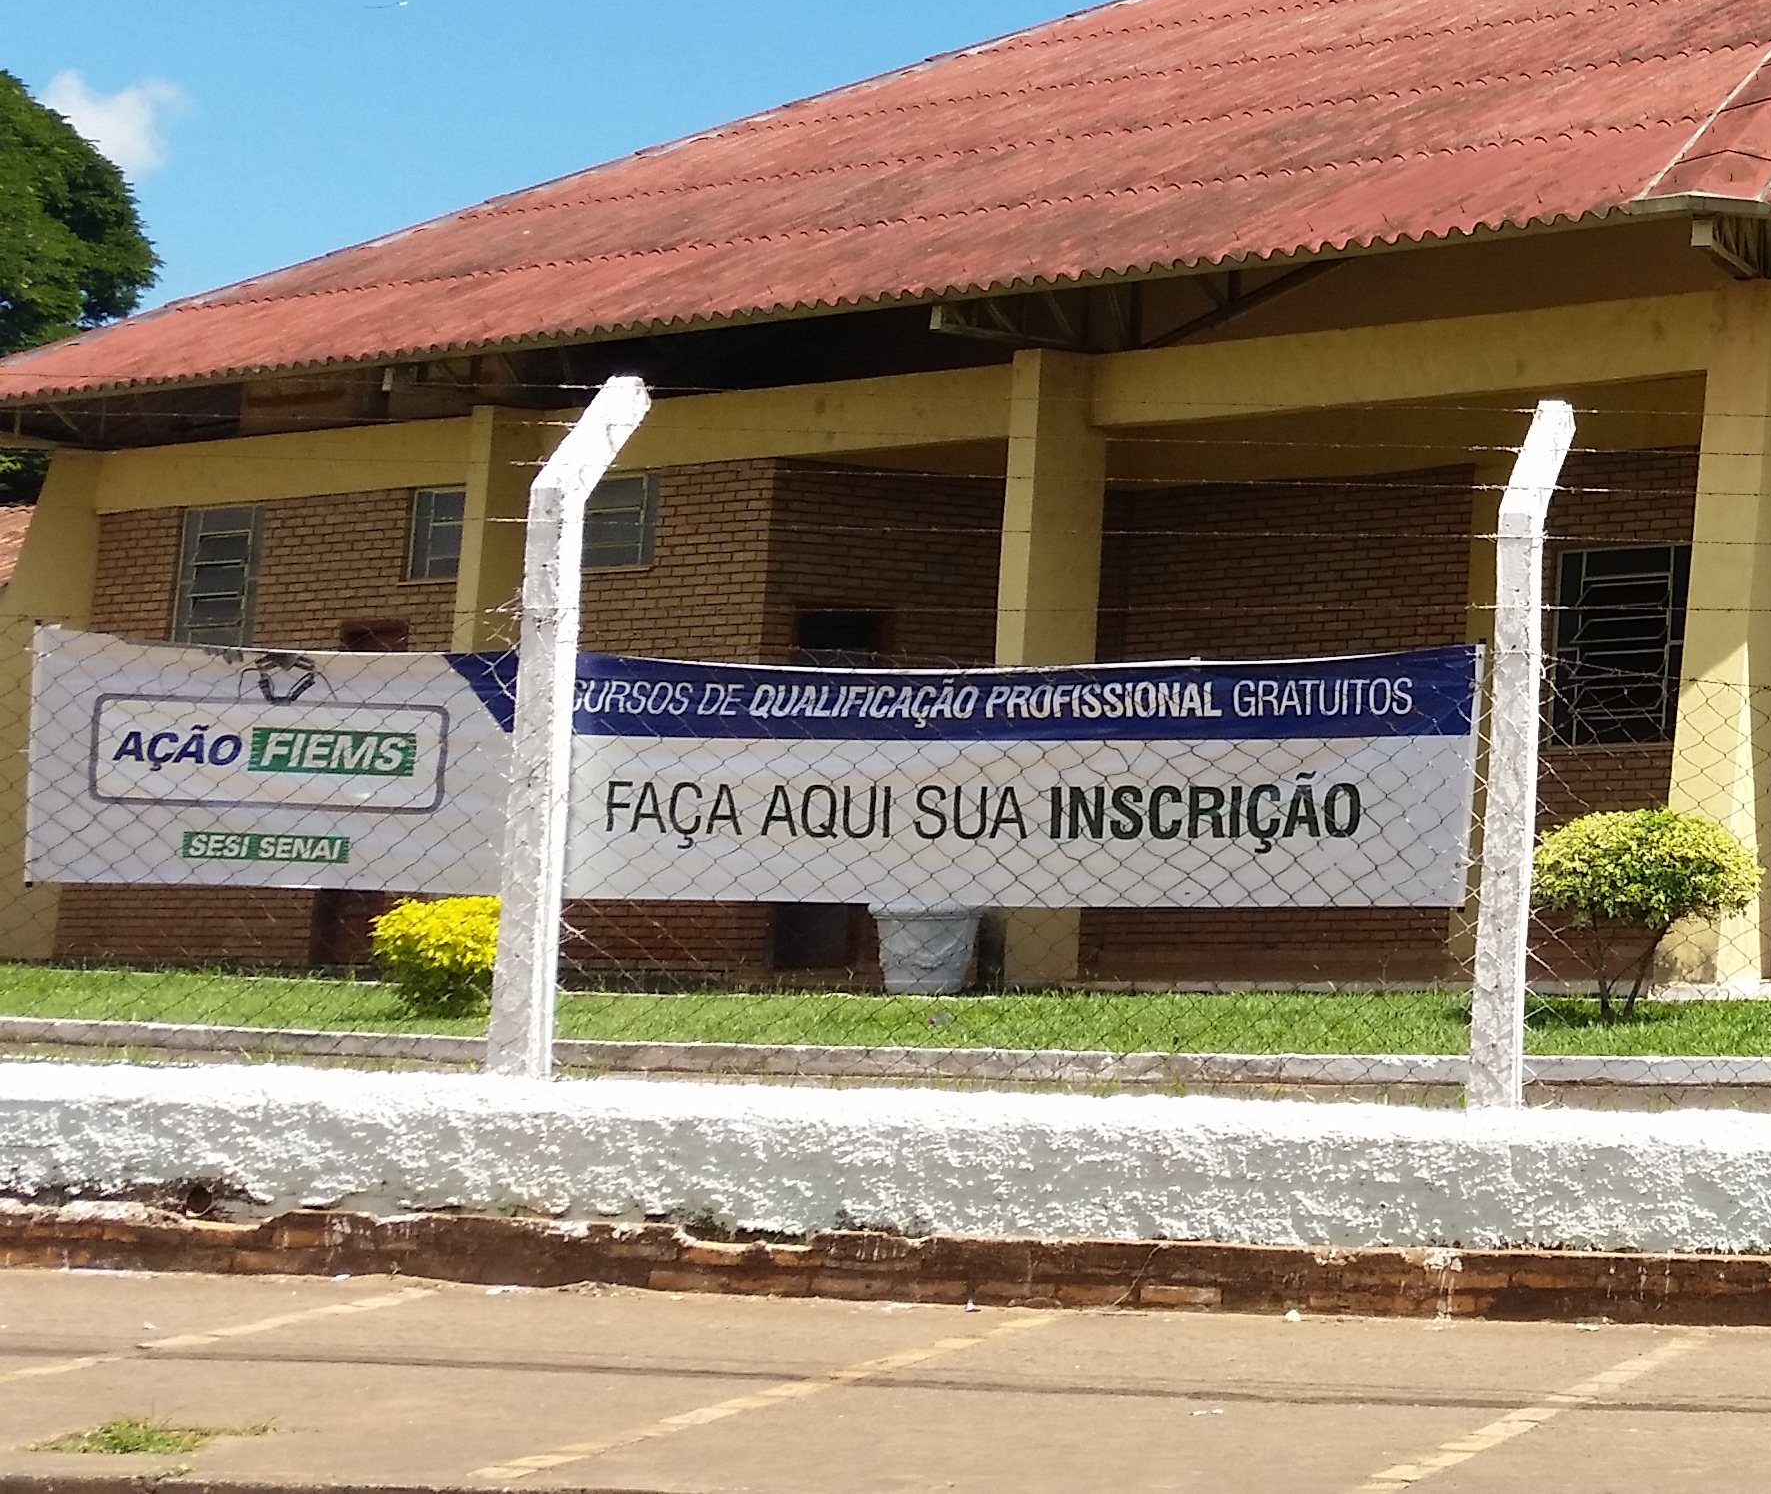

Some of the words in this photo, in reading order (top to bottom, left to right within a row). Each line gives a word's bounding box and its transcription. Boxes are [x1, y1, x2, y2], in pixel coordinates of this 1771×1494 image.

[697, 683, 745, 717] DE
[748, 679, 980, 728] QUALIFICAÇÃO
[984, 679, 1223, 719] PROFISSIONAL
[1232, 677, 1414, 717] GRATUITOS
[113, 724, 242, 771] AÇÃO
[260, 732, 408, 772] FIEMS
[605, 780, 743, 849] FAÇA
[761, 784, 892, 840] AQUI
[914, 785, 1028, 840] SUA
[1049, 770, 1361, 854] INSCRIÇÃO
[188, 834, 249, 858] SESI
[257, 837, 342, 861] SENAI
